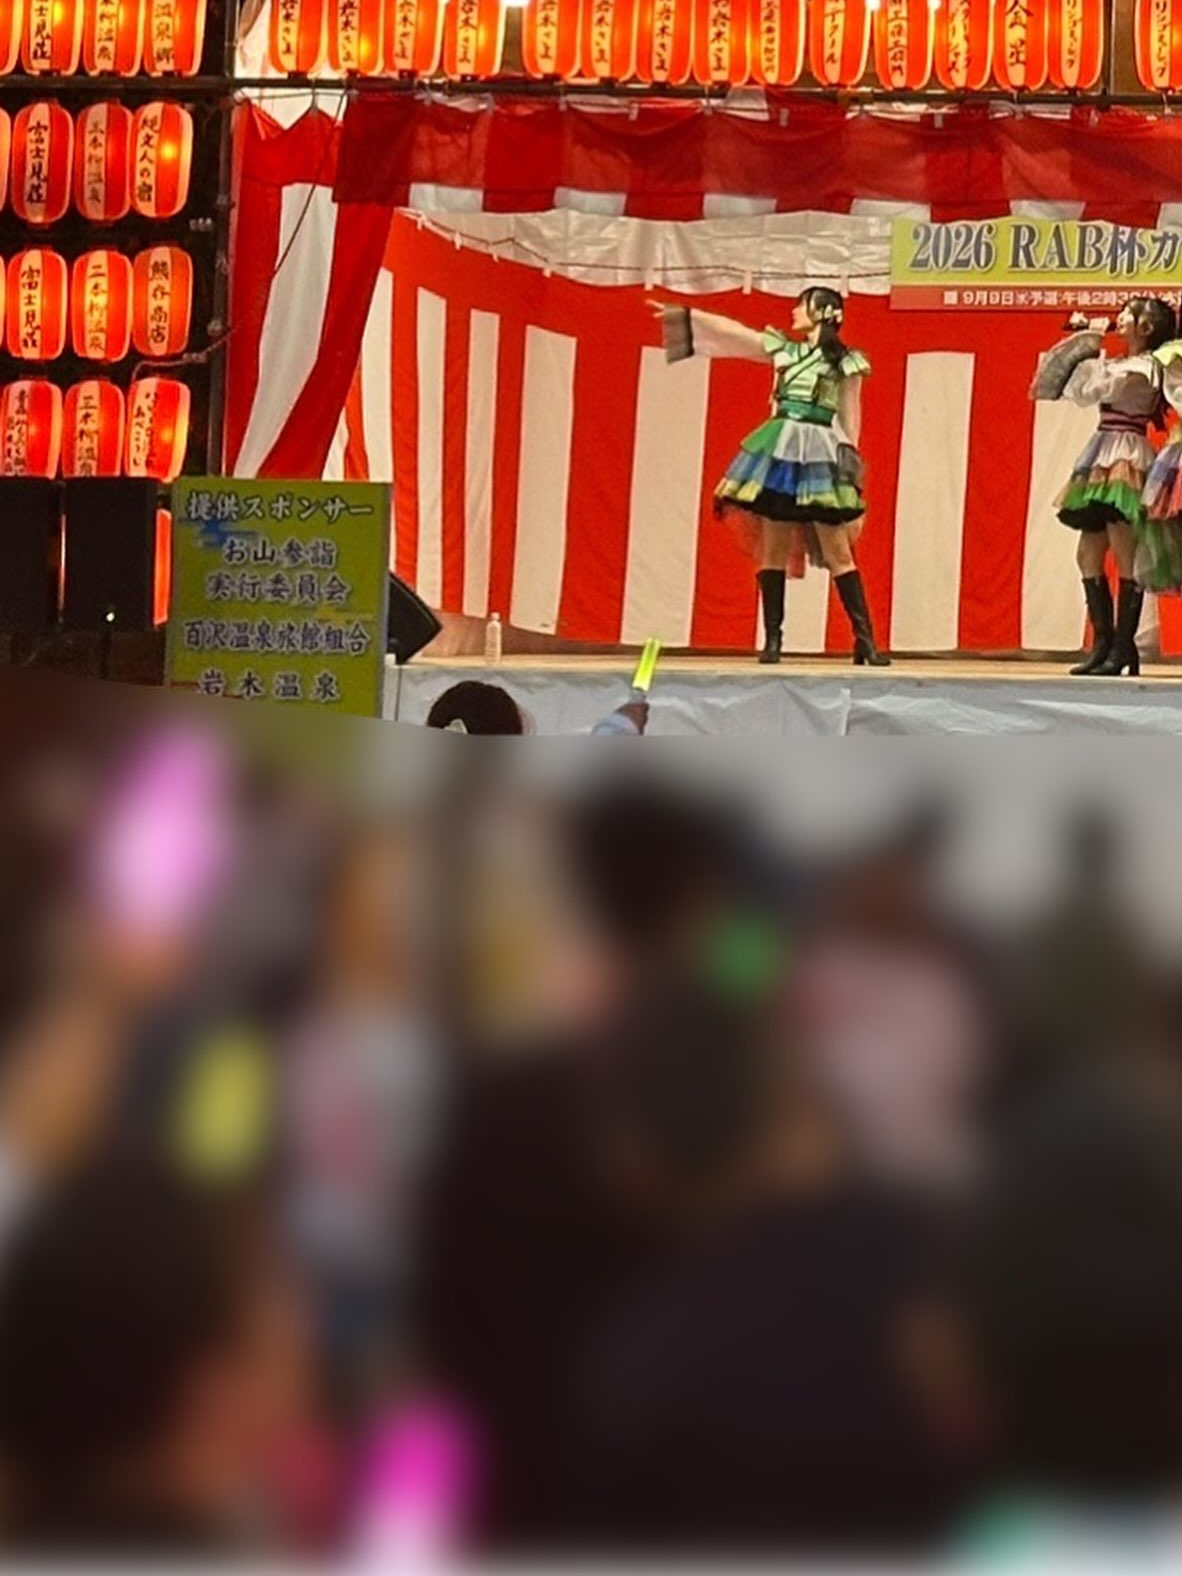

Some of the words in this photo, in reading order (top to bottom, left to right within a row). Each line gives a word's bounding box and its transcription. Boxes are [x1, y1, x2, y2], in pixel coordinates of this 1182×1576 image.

[909, 222, 994, 271] 2026
[187, 491, 374, 522] 提供スポンサー
[223, 538, 336, 567] お山参詣
[207, 572, 350, 602] 実行委員会
[184, 619, 371, 655] 百沢温泉旅館組合
[200, 668, 339, 702] 岩木温泉
